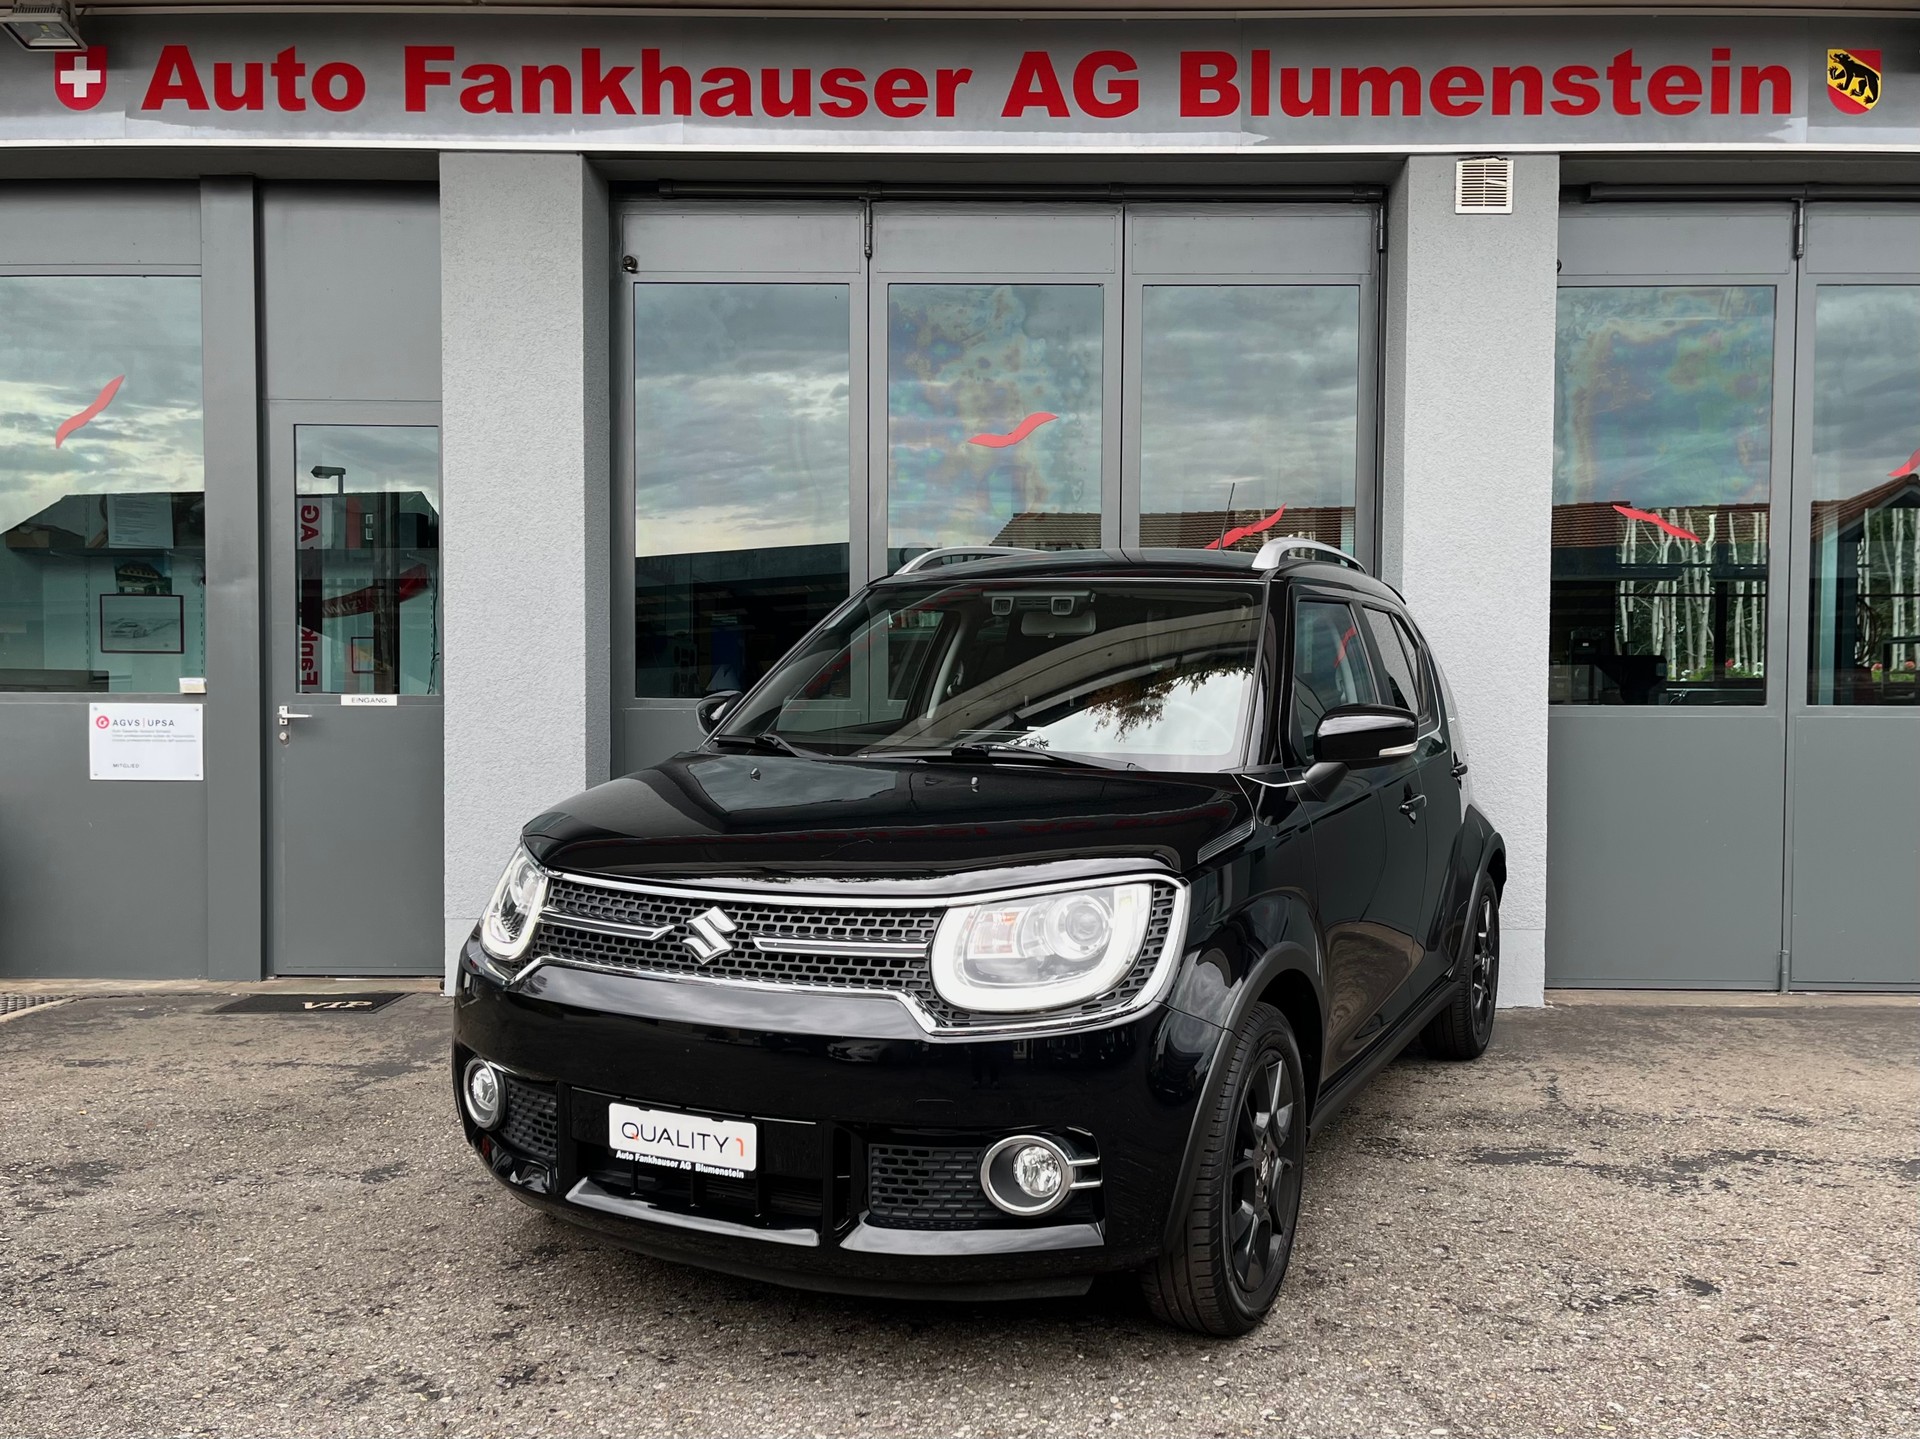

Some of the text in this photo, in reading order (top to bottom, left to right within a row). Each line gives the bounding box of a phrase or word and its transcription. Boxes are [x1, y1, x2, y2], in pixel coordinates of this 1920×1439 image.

[143, 45, 1792, 118] Auto Fankhauser AG Blumenstein
[350, 696, 388, 704] EINGANG
[112, 719, 175, 727] AGVS UPSA
[303, 1001, 373, 1010] VIP
[615, 1149, 745, 1179] Auto Fankhauser AG Blumenstein
